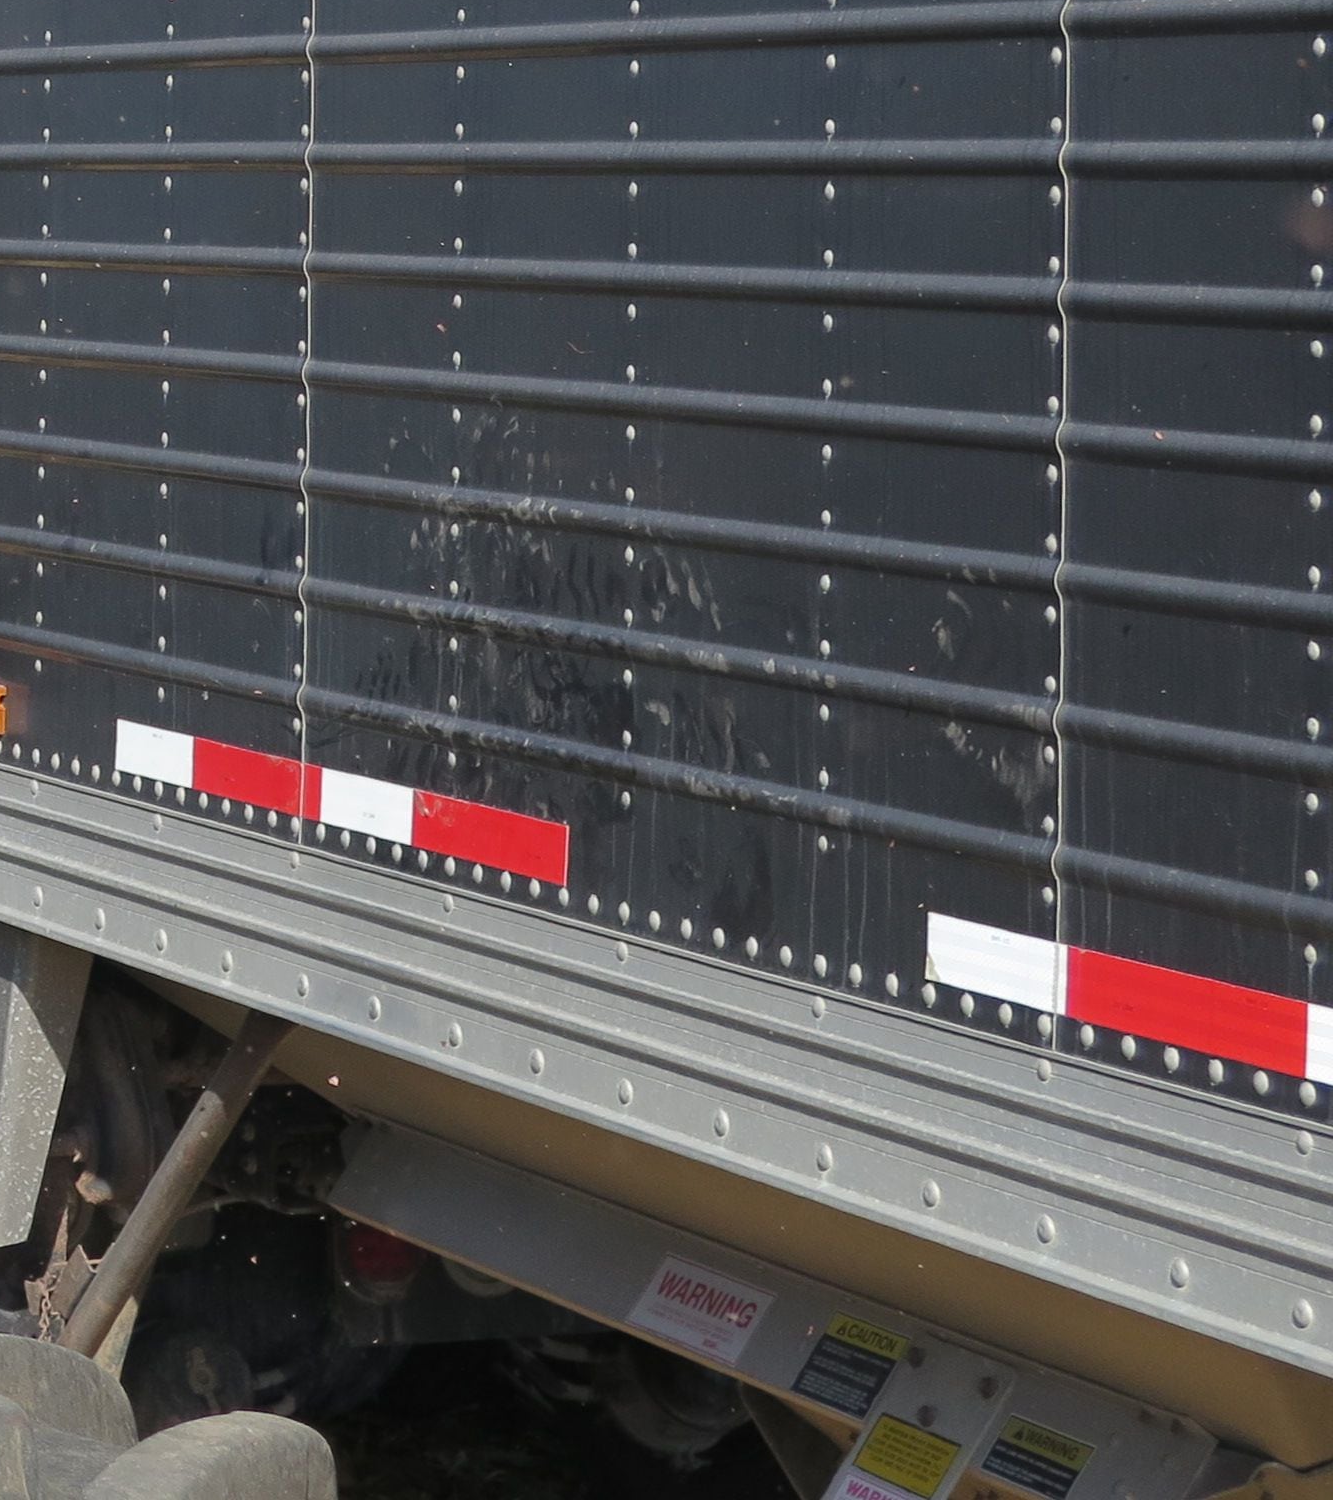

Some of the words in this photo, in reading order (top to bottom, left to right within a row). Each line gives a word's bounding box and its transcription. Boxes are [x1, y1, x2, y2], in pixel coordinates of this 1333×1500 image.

[658, 1270, 757, 1328] WARNING
[847, 1325, 898, 1353] CAUTION
[1025, 1428, 1080, 1461] WARNING
